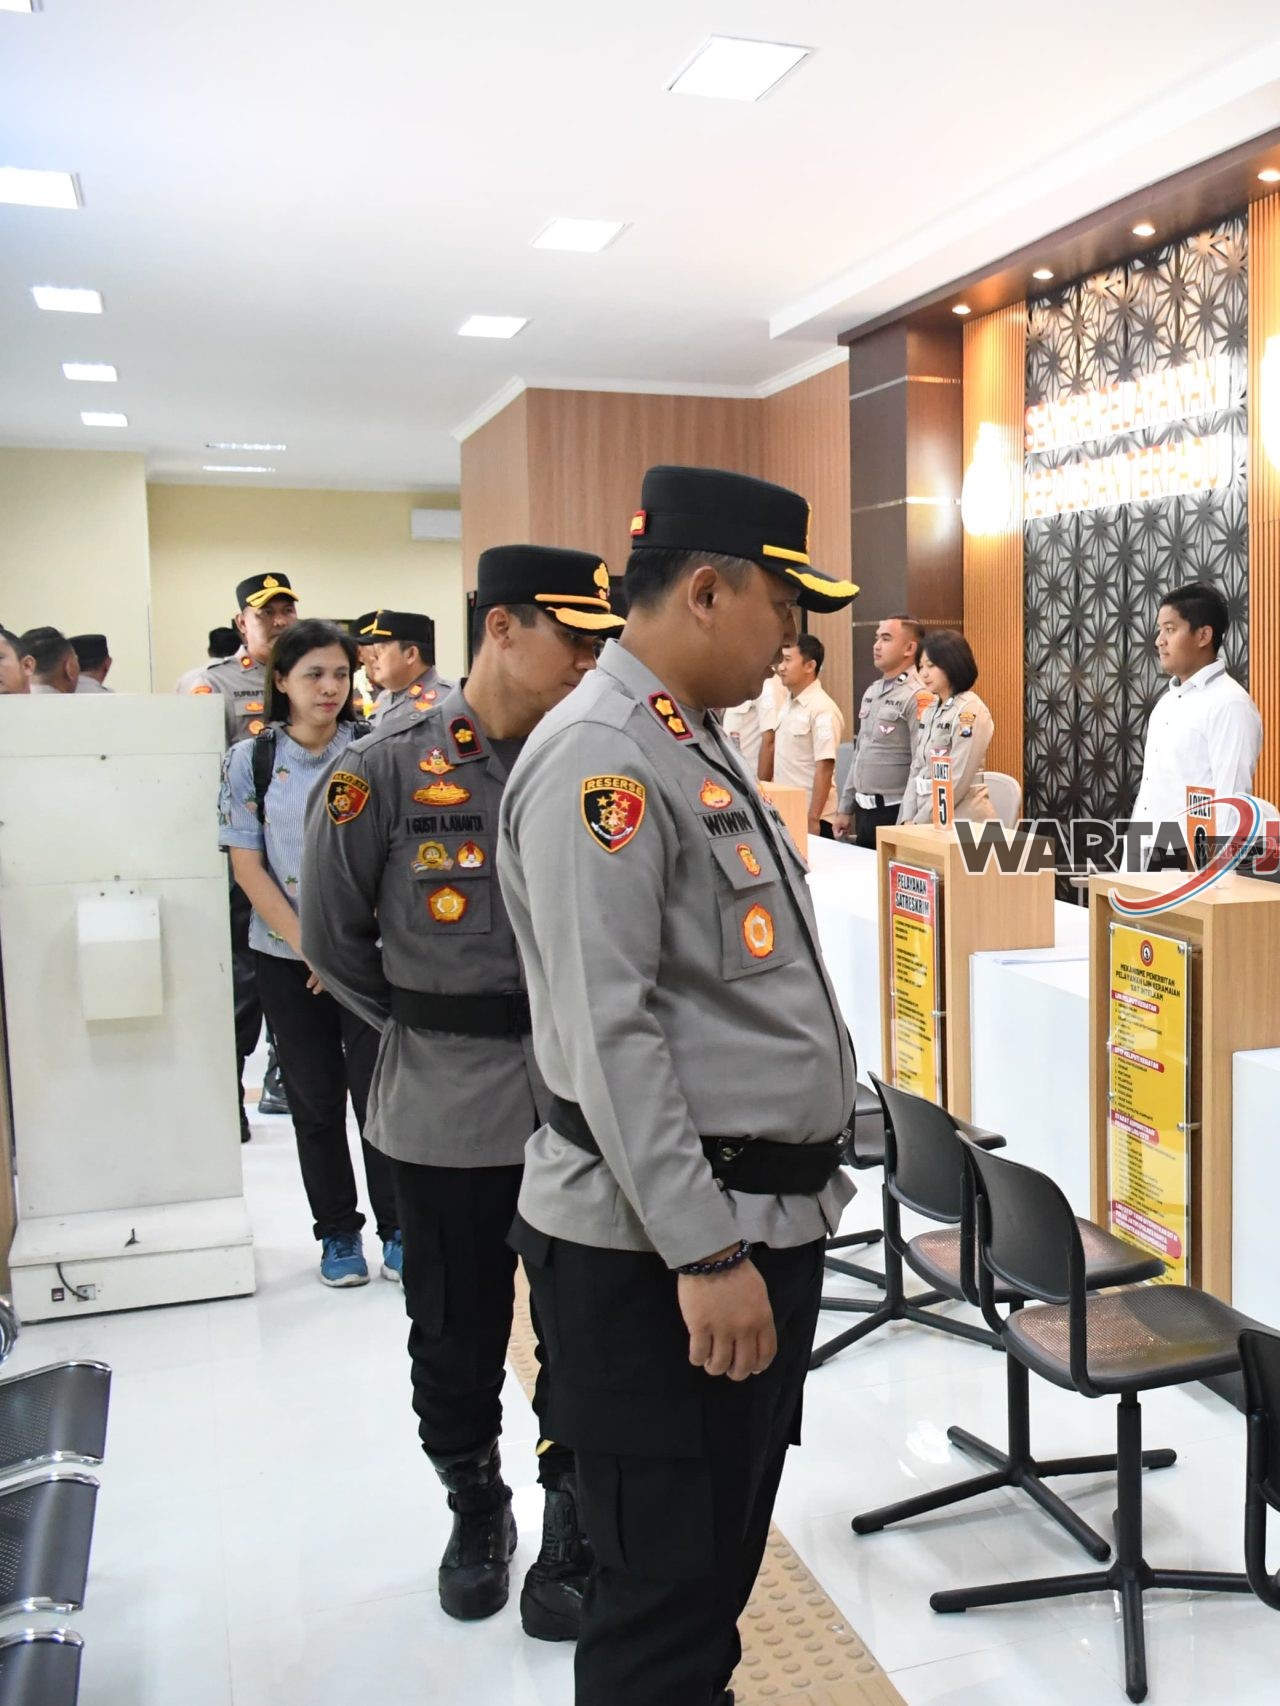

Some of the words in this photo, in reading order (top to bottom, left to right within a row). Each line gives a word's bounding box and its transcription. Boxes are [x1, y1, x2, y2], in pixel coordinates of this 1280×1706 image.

[586, 778, 643, 797] RESERSE
[938, 788, 947, 825] 5
[1189, 794, 1212, 817] LOKET
[413, 815, 437, 833] GUSTI
[702, 810, 753, 836] WIWIN
[895, 892, 930, 917] SATRESKRIM
[1146, 970, 1175, 987] PENERBITAN
